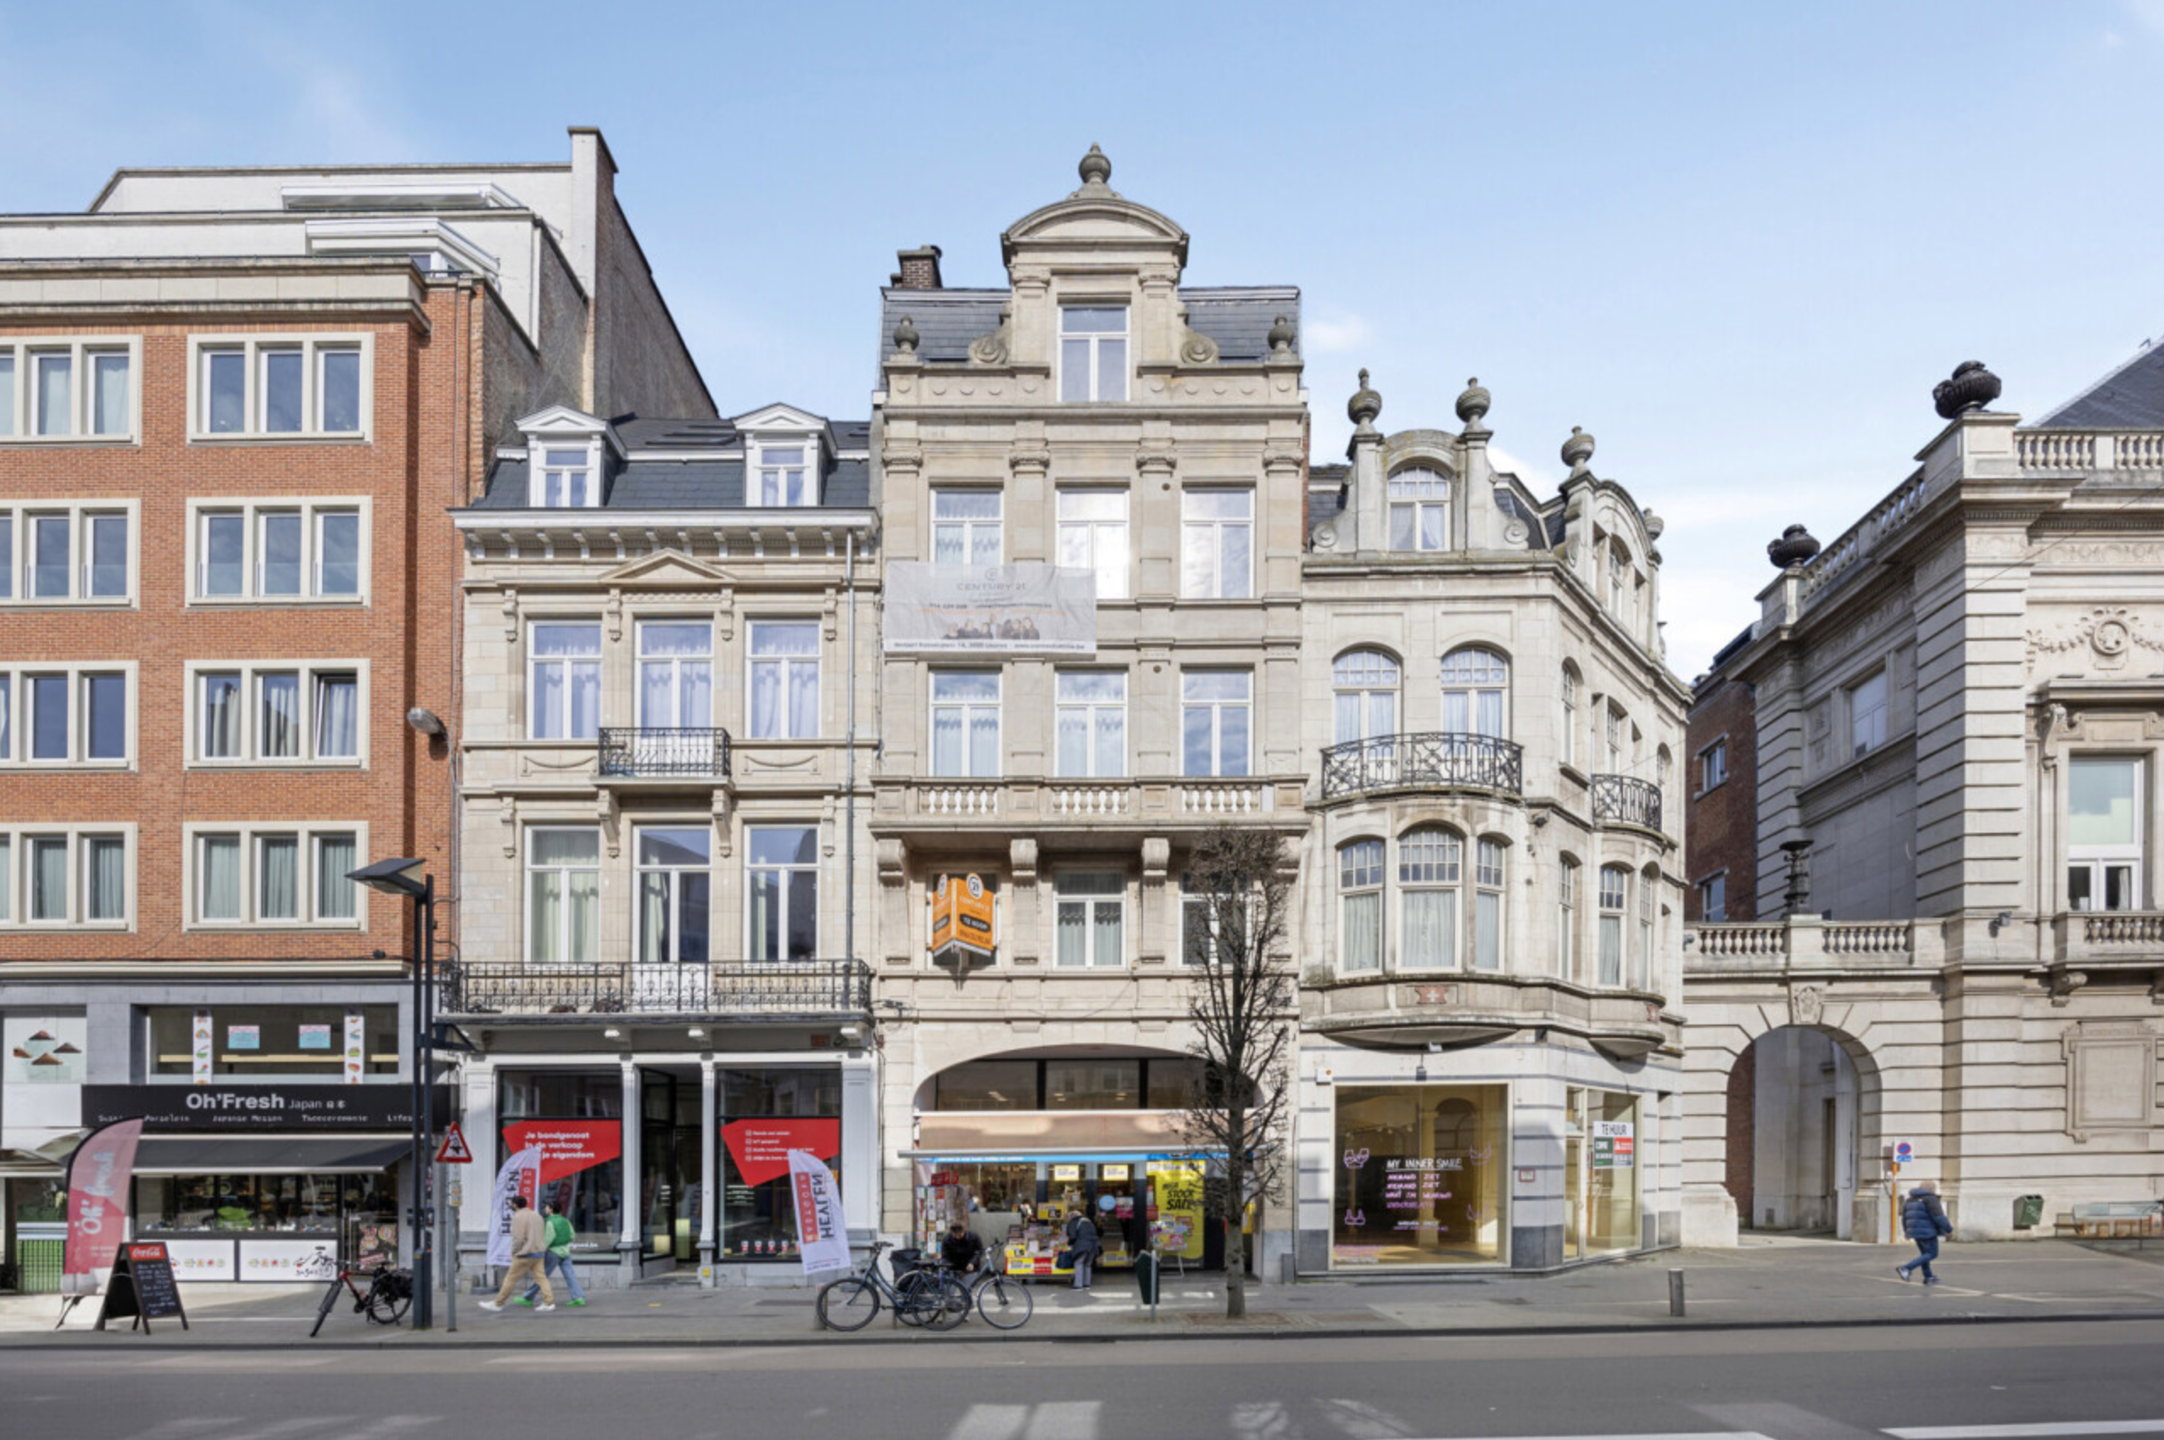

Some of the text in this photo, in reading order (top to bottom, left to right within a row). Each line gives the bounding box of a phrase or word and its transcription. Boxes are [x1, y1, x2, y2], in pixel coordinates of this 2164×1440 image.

[957, 582, 1012, 591] CENTURY
[186, 1093, 323, 1111] Oh'Fresh Japan
[1602, 1123, 1610, 1136] TE
[538, 1131, 590, 1140] bondgenoot
[548, 1141, 583, 1151] verkoop
[552, 1151, 595, 1161] eigendom
[1386, 1157, 1462, 1169] MY INNER SMILE
